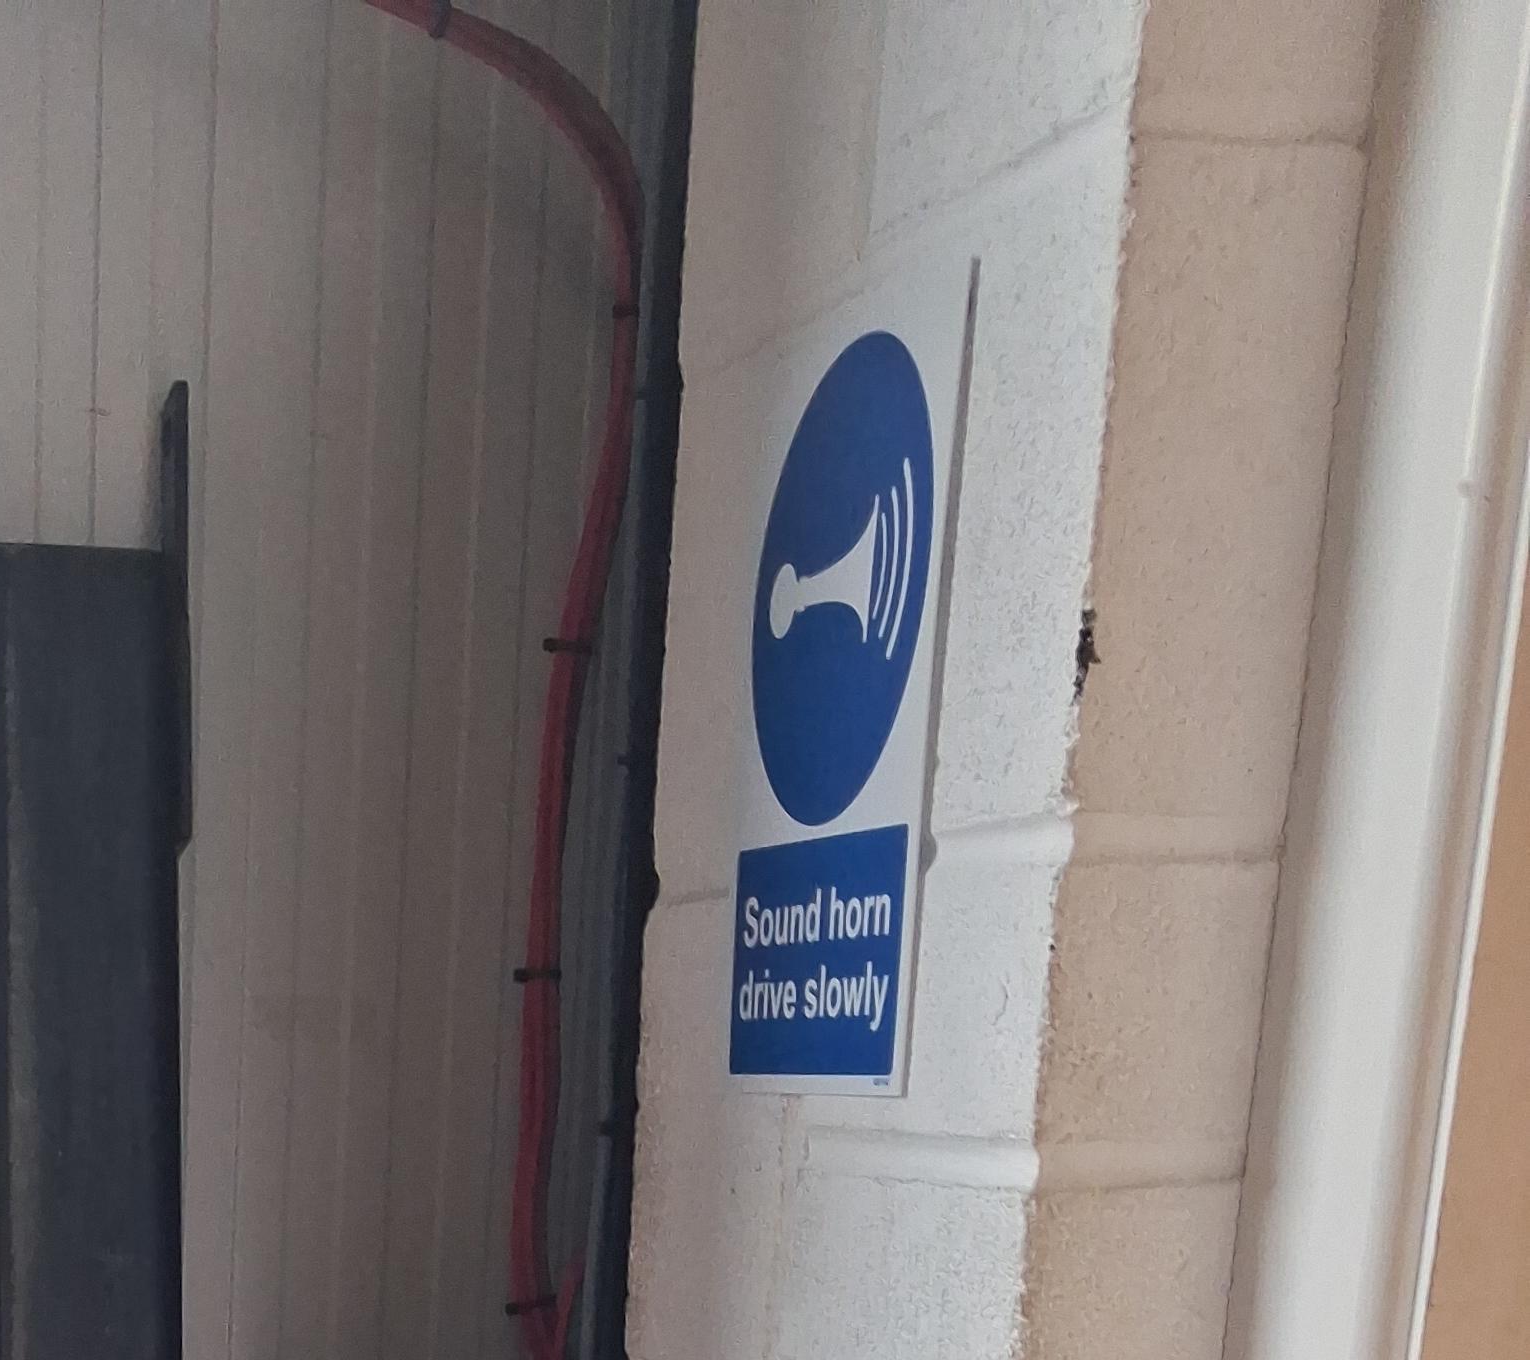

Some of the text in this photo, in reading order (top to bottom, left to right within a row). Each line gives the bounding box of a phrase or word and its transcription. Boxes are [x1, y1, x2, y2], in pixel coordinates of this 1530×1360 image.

[743, 886, 891, 948] Sound horn
[739, 961, 889, 1031] drive slowly
